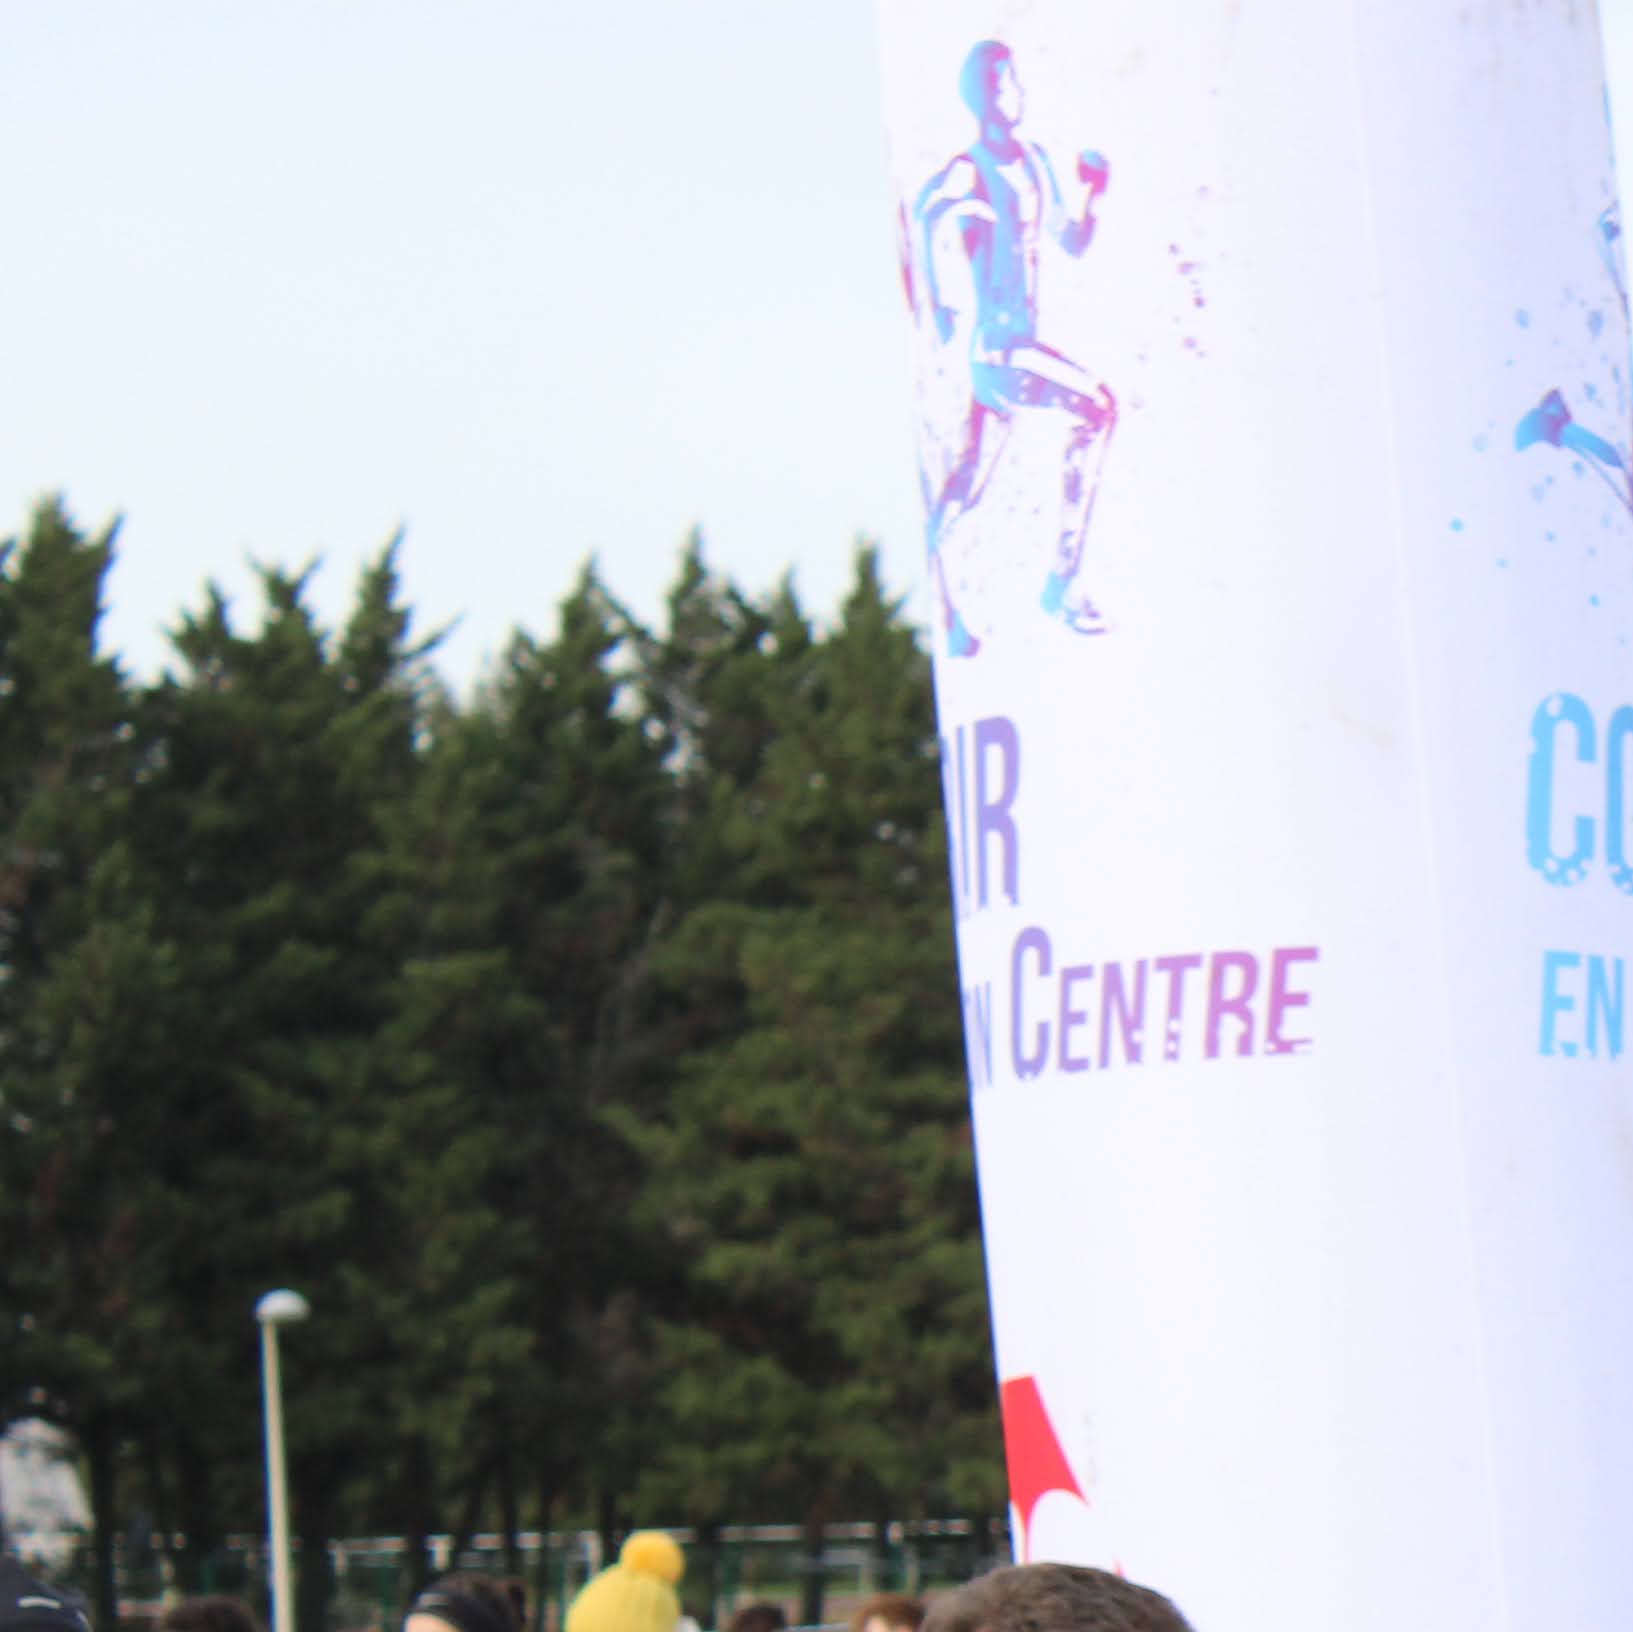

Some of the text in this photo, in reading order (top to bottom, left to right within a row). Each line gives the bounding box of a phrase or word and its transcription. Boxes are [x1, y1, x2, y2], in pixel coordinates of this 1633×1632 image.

[942, 716, 1020, 910] IR
[1010, 926, 1320, 1081] CENTRE
[1540, 949, 1625, 1061] EN
